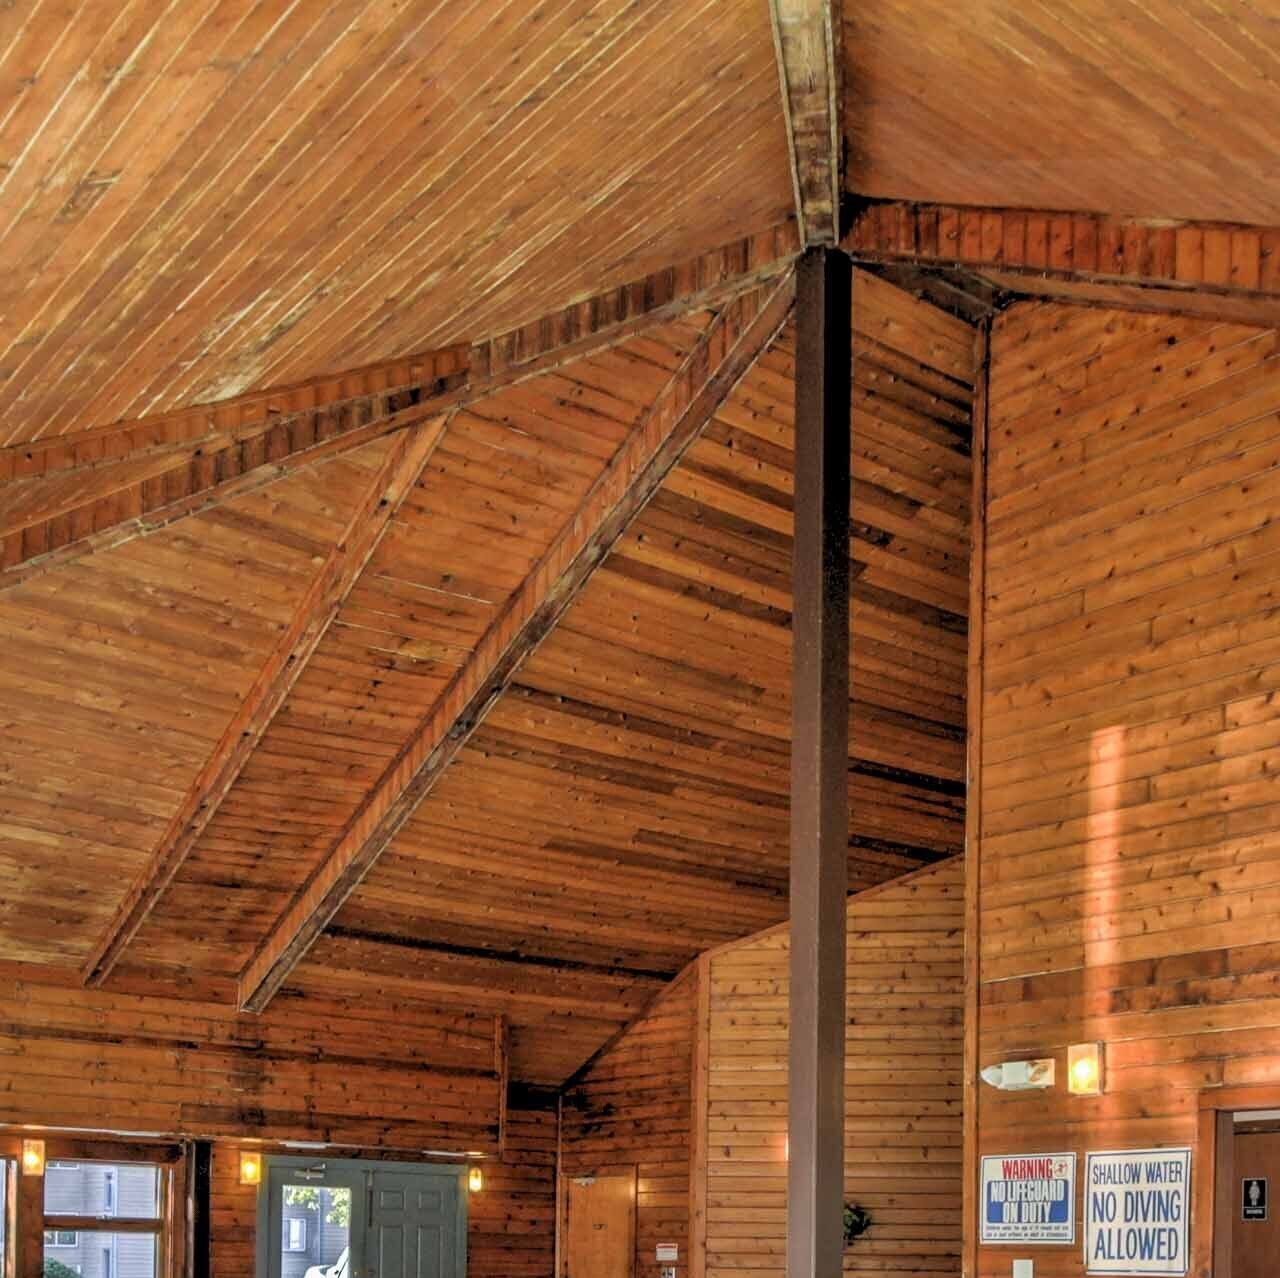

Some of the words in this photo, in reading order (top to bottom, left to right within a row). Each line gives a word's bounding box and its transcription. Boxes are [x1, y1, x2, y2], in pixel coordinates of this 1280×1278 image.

[1002, 1158, 1053, 1179] WARNING
[1093, 1163, 1141, 1185] SHALLOW
[1145, 1161, 1182, 1183] WATER
[991, 1181, 1005, 1202] NO
[1007, 1180, 1064, 1202] LIFEGUARD
[1003, 1202, 1017, 1223] ON
[1022, 1201, 1051, 1223] DUTY
[1093, 1191, 1116, 1222] NO
[1124, 1190, 1181, 1222] DIVING
[1094, 1228, 1178, 1260] ALLOWED
